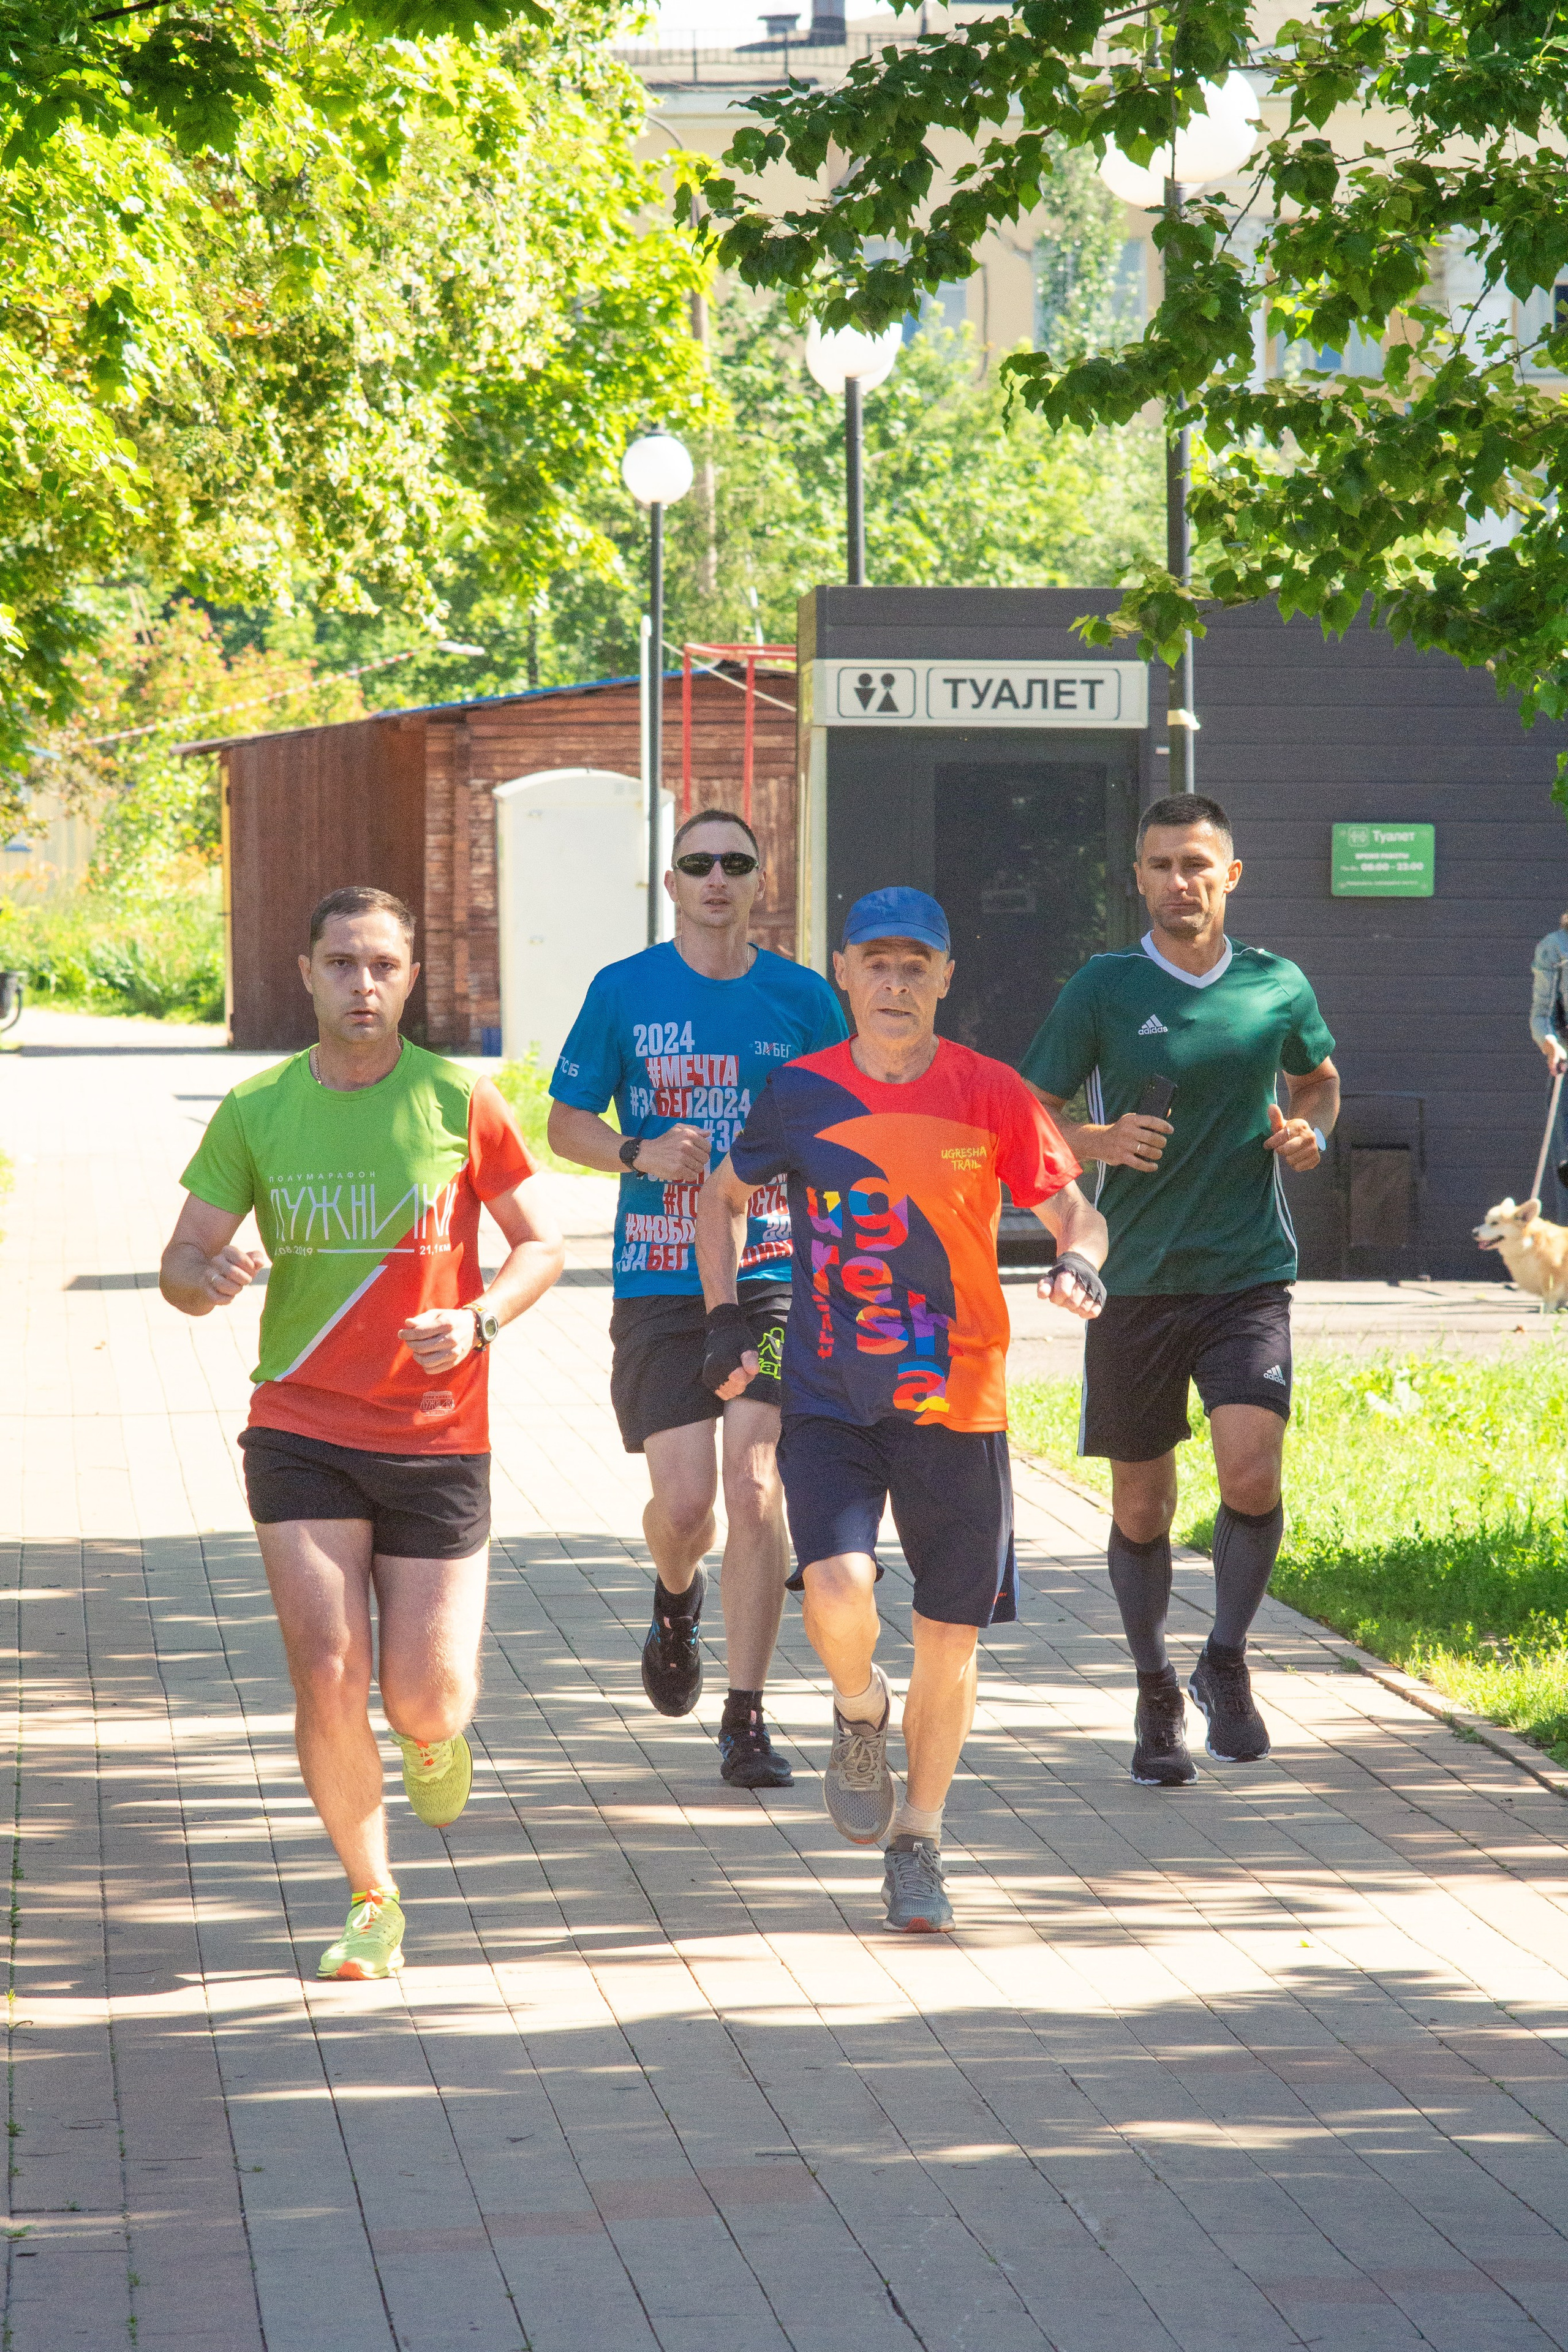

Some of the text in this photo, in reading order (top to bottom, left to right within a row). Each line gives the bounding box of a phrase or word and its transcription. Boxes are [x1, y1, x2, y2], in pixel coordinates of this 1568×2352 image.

[943, 678, 1104, 710] ТУАЛЕТ
[1138, 1026, 1168, 1035] adidas
[633, 1020, 695, 1057] 2024
[647, 1055, 739, 1087] #МЕЧТА
[941, 1145, 987, 1159] UGRESHA
[951, 1159, 981, 1170] TRAIL
[269, 1170, 375, 1183] ПОЛУМАРАФОН
[625, 1213, 696, 1244] #ЛЮБО
[1263, 1372, 1286, 1386] adidas
